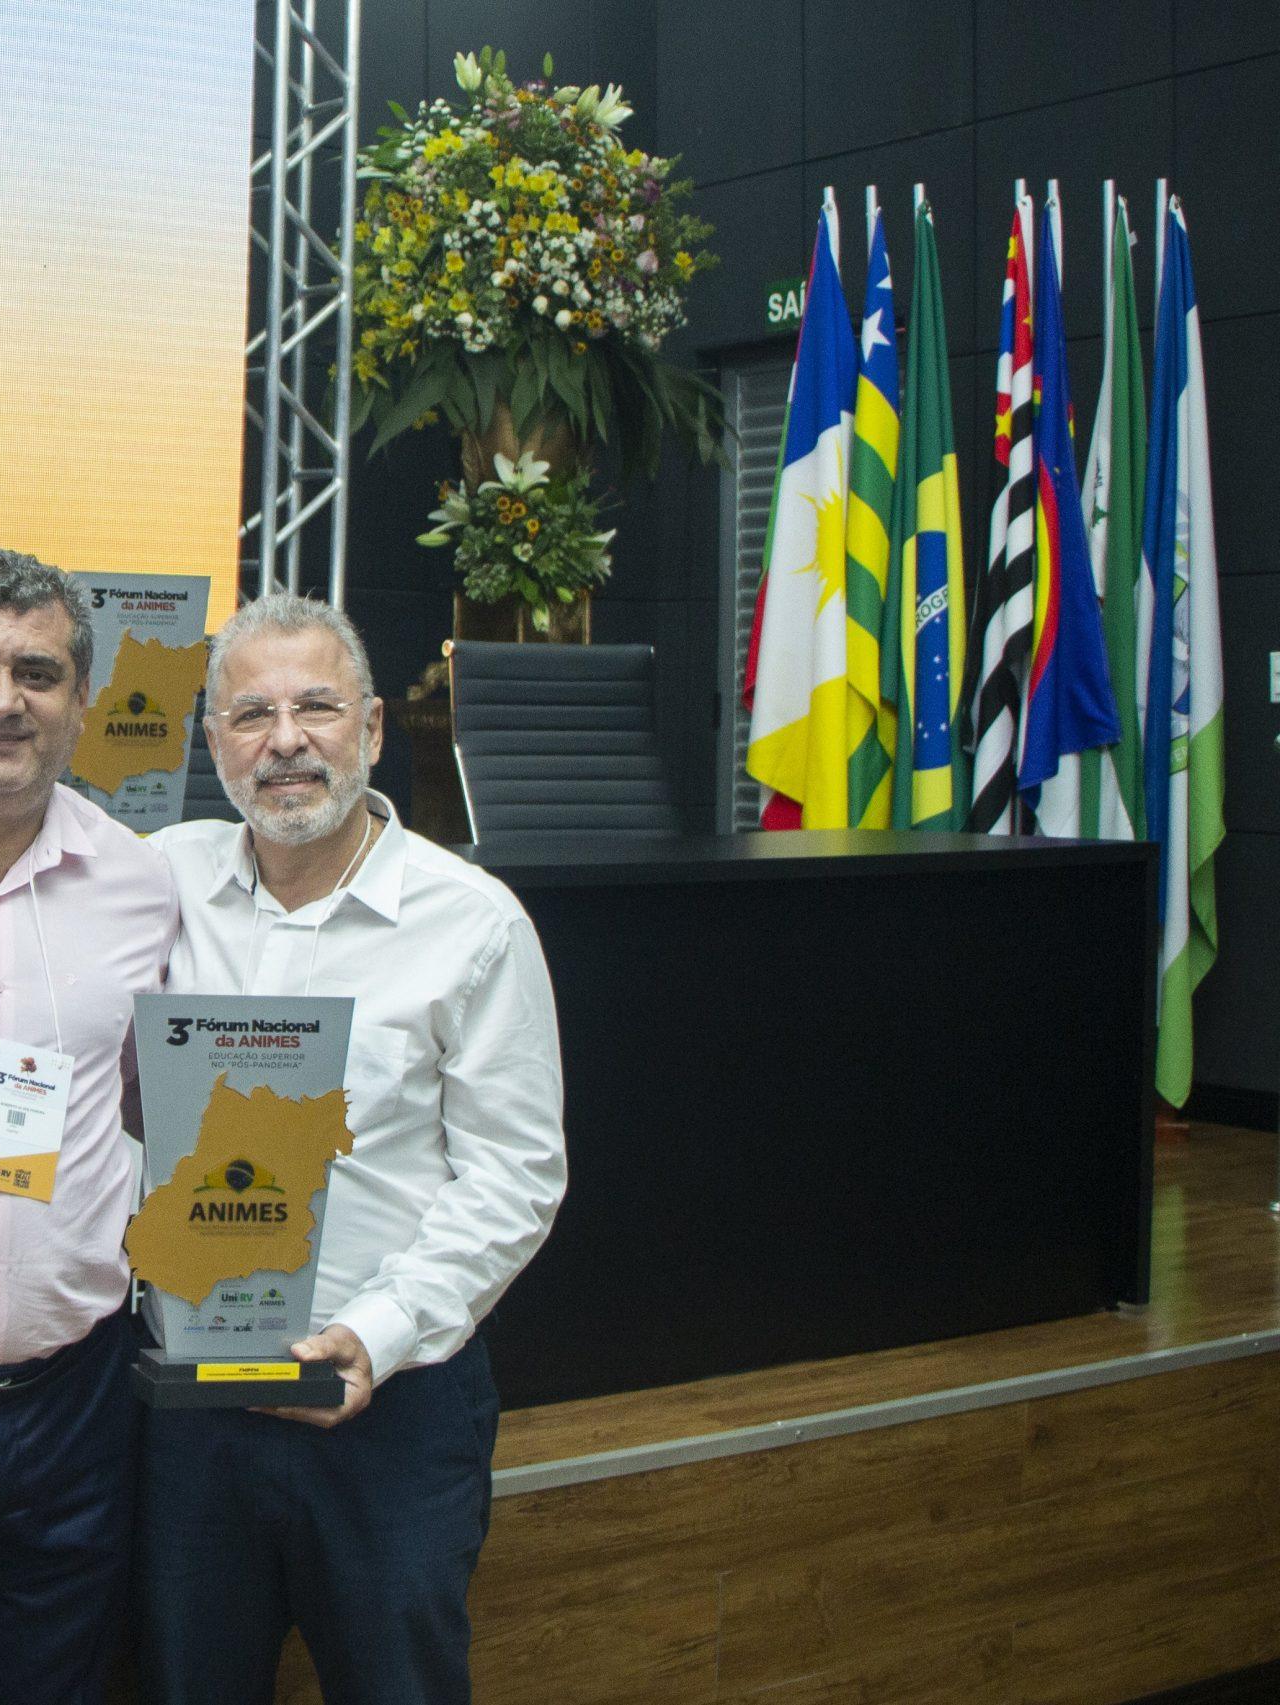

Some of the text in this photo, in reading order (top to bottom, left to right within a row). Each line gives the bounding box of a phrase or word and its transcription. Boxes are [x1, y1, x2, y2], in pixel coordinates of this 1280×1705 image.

[768, 281, 806, 322] SAÍ
[109, 588, 142, 599] Fórum
[145, 590, 188, 601] Nacional
[121, 601, 176, 611] da ANIMES
[104, 722, 168, 737] ANIMES
[196, 1018, 249, 1032] Fórum
[251, 1019, 320, 1033] Nacional
[215, 1034, 300, 1048] da ANIMES
[208, 1052, 305, 1062] EDUCAÇÃO SUPERIOR
[29, 1078, 56, 1090] Nacional
[188, 1202, 289, 1222] ANIMES
[221, 1291, 254, 1303] Uni RV
